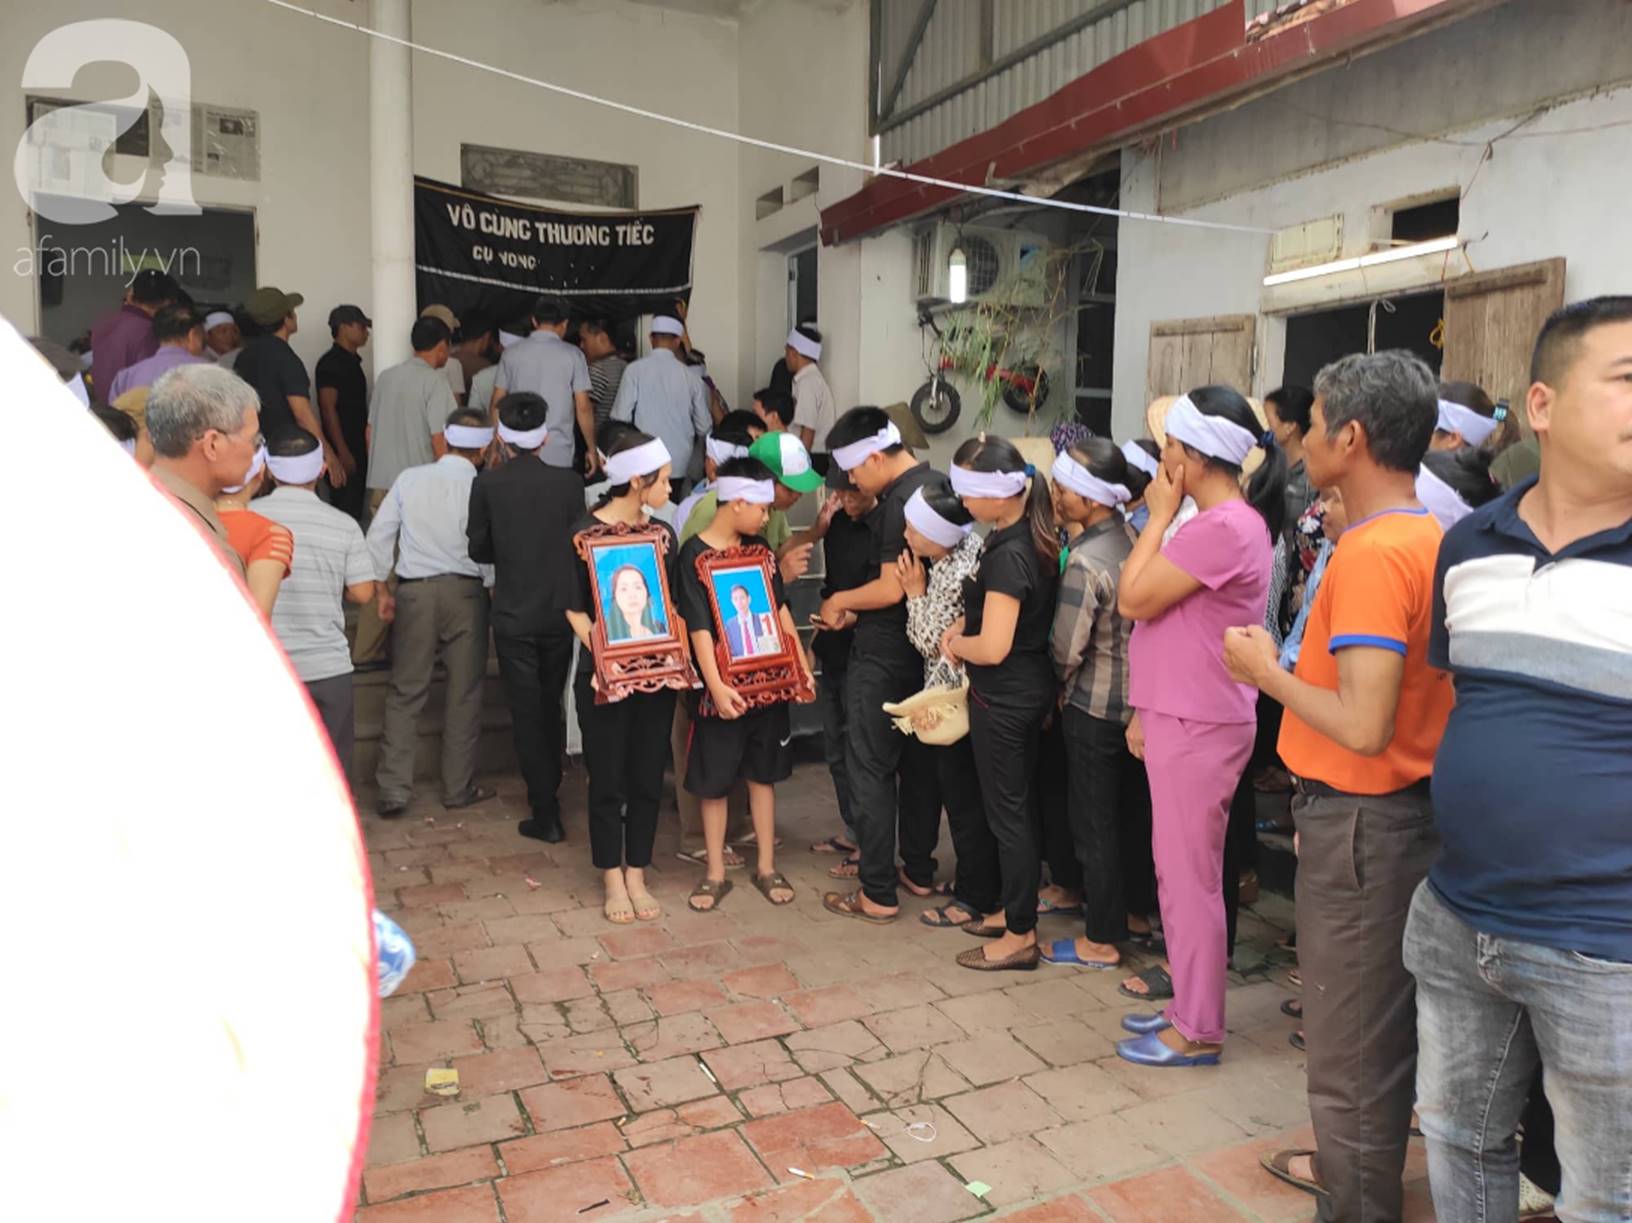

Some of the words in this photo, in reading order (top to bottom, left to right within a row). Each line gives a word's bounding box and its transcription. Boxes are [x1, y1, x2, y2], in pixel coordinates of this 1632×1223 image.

[446, 203, 476, 230] VÔ
[479, 209, 532, 240] CÙNG
[615, 217, 655, 246] TIẾC
